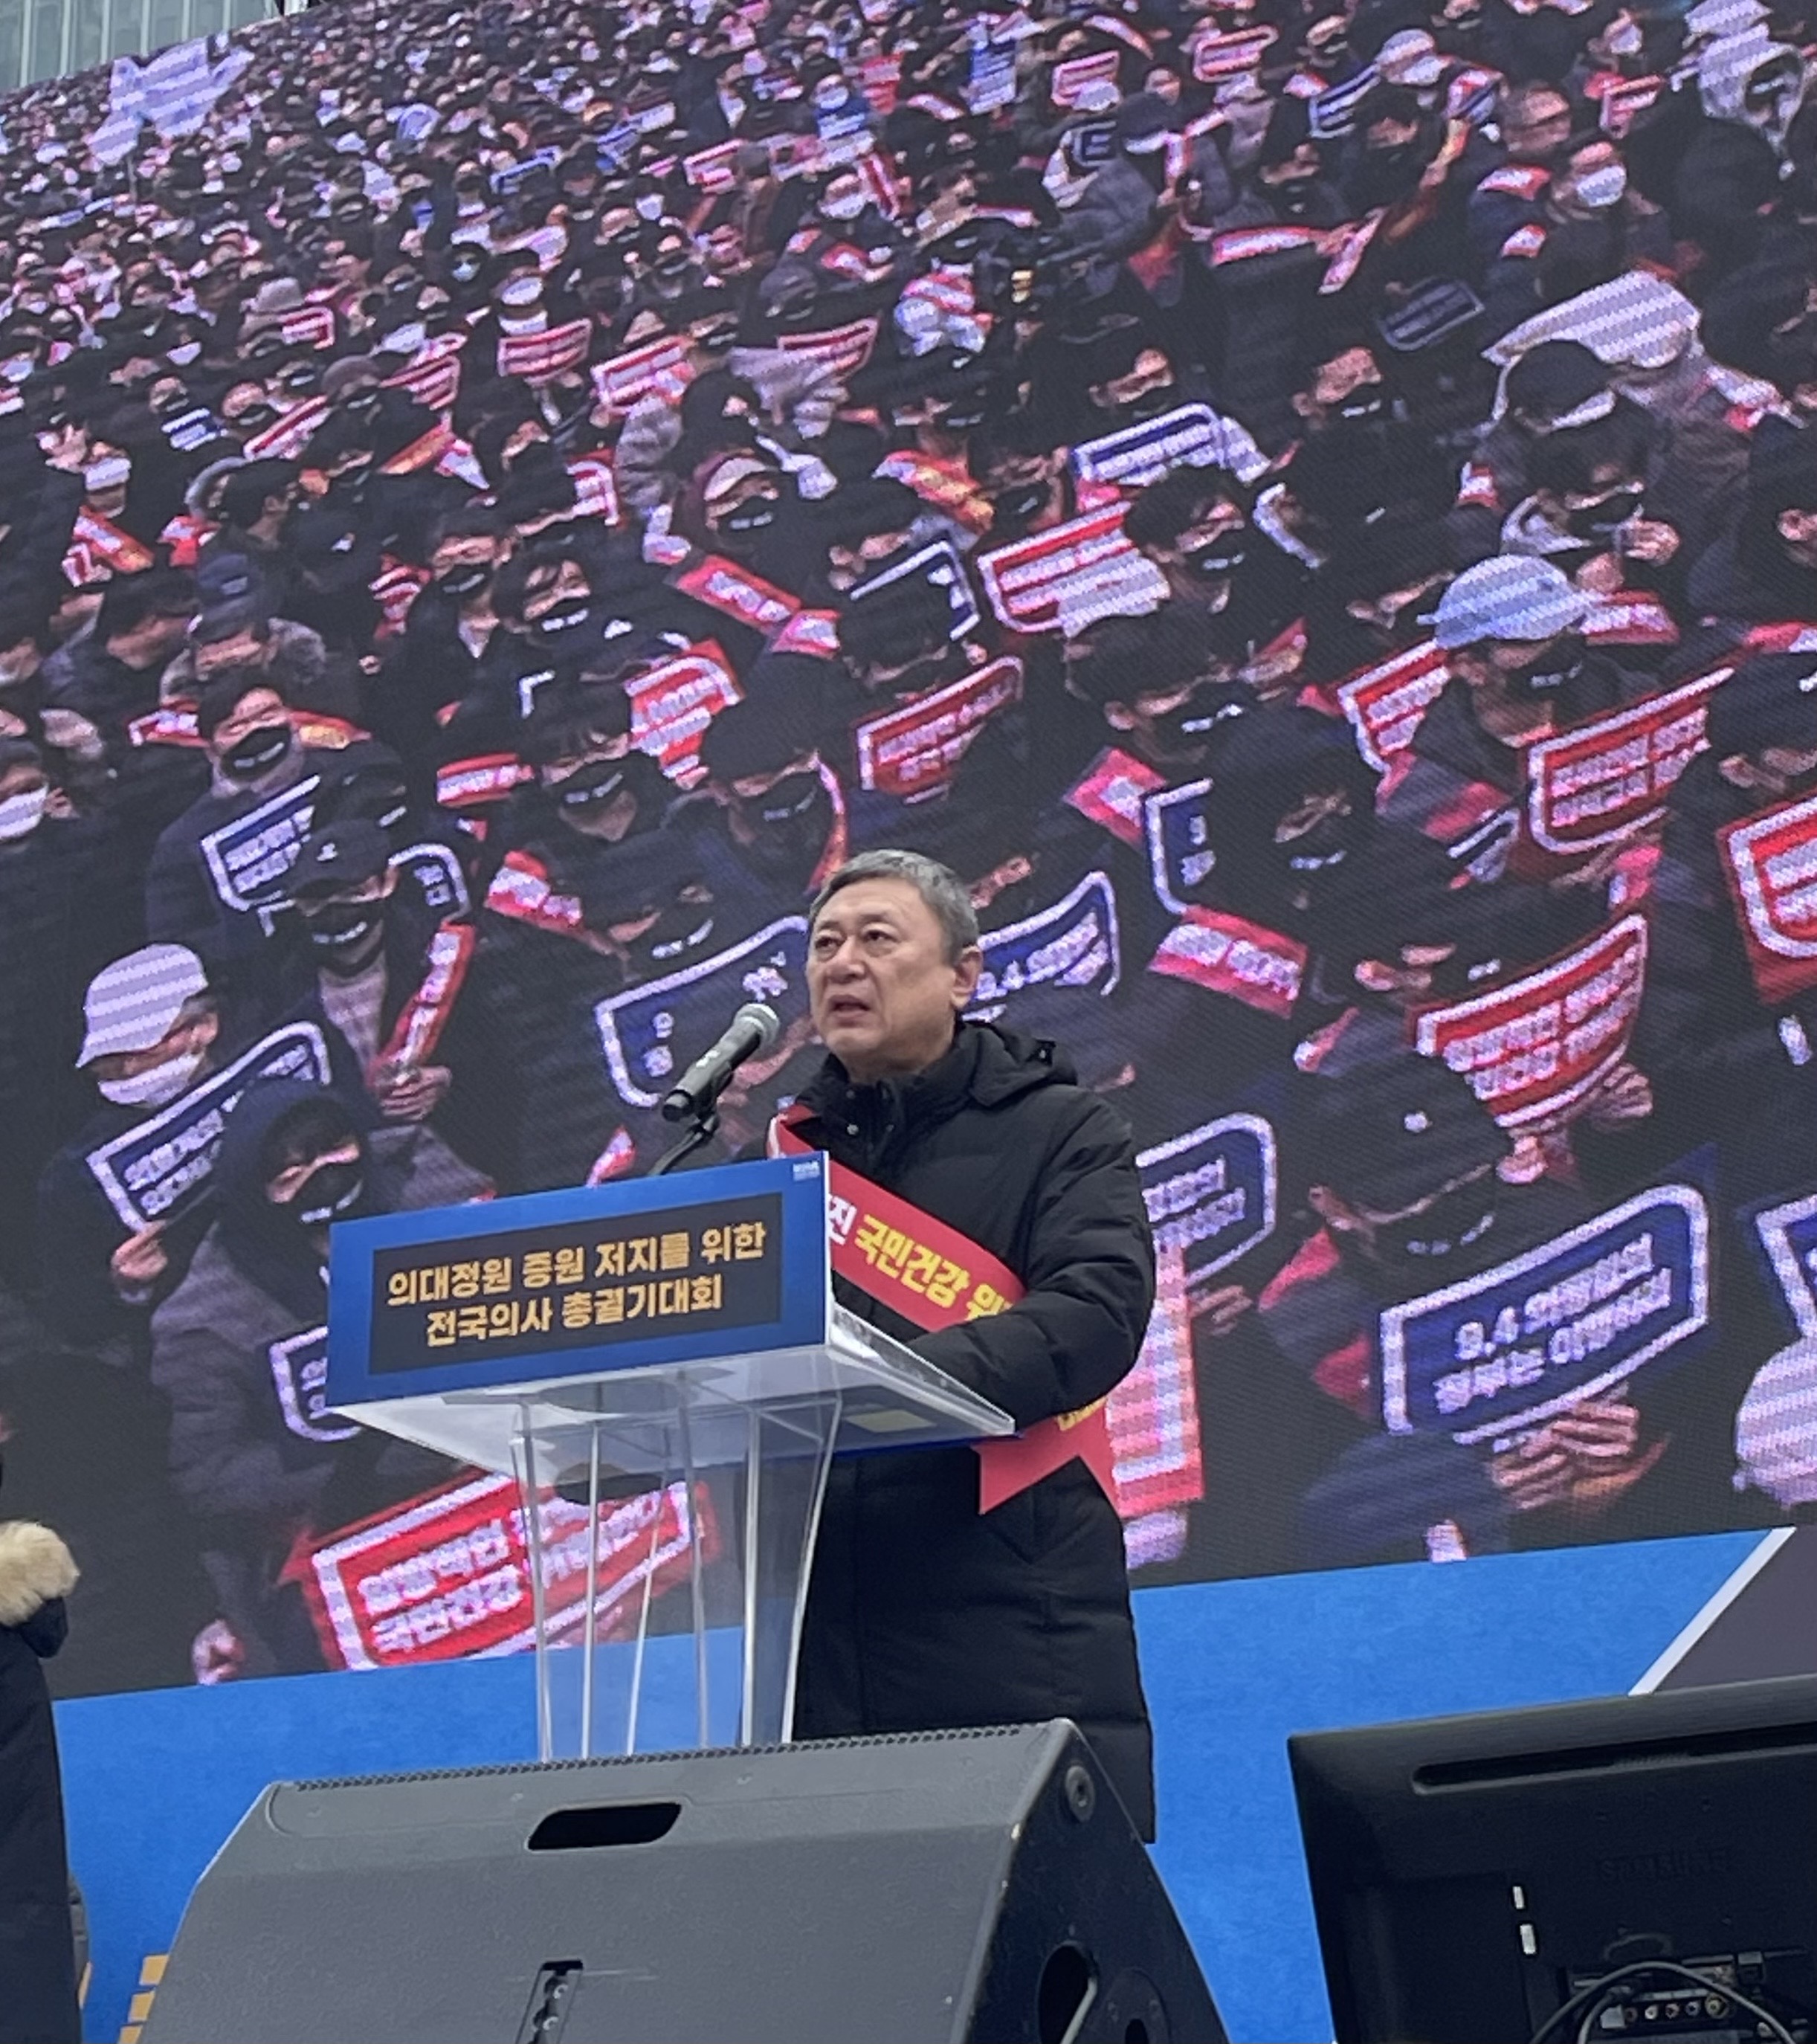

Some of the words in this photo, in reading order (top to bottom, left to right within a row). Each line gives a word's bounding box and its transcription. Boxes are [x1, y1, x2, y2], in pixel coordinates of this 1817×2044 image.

[387, 1257, 512, 1306] 의대정원
[522, 1246, 585, 1290] 증원
[595, 1232, 690, 1278] 저지를
[701, 1221, 767, 1263] 위한
[854, 1213, 972, 1309] 국민건강
[426, 1296, 555, 1347] 전국의사
[561, 1274, 723, 1329] 총궐기대회
